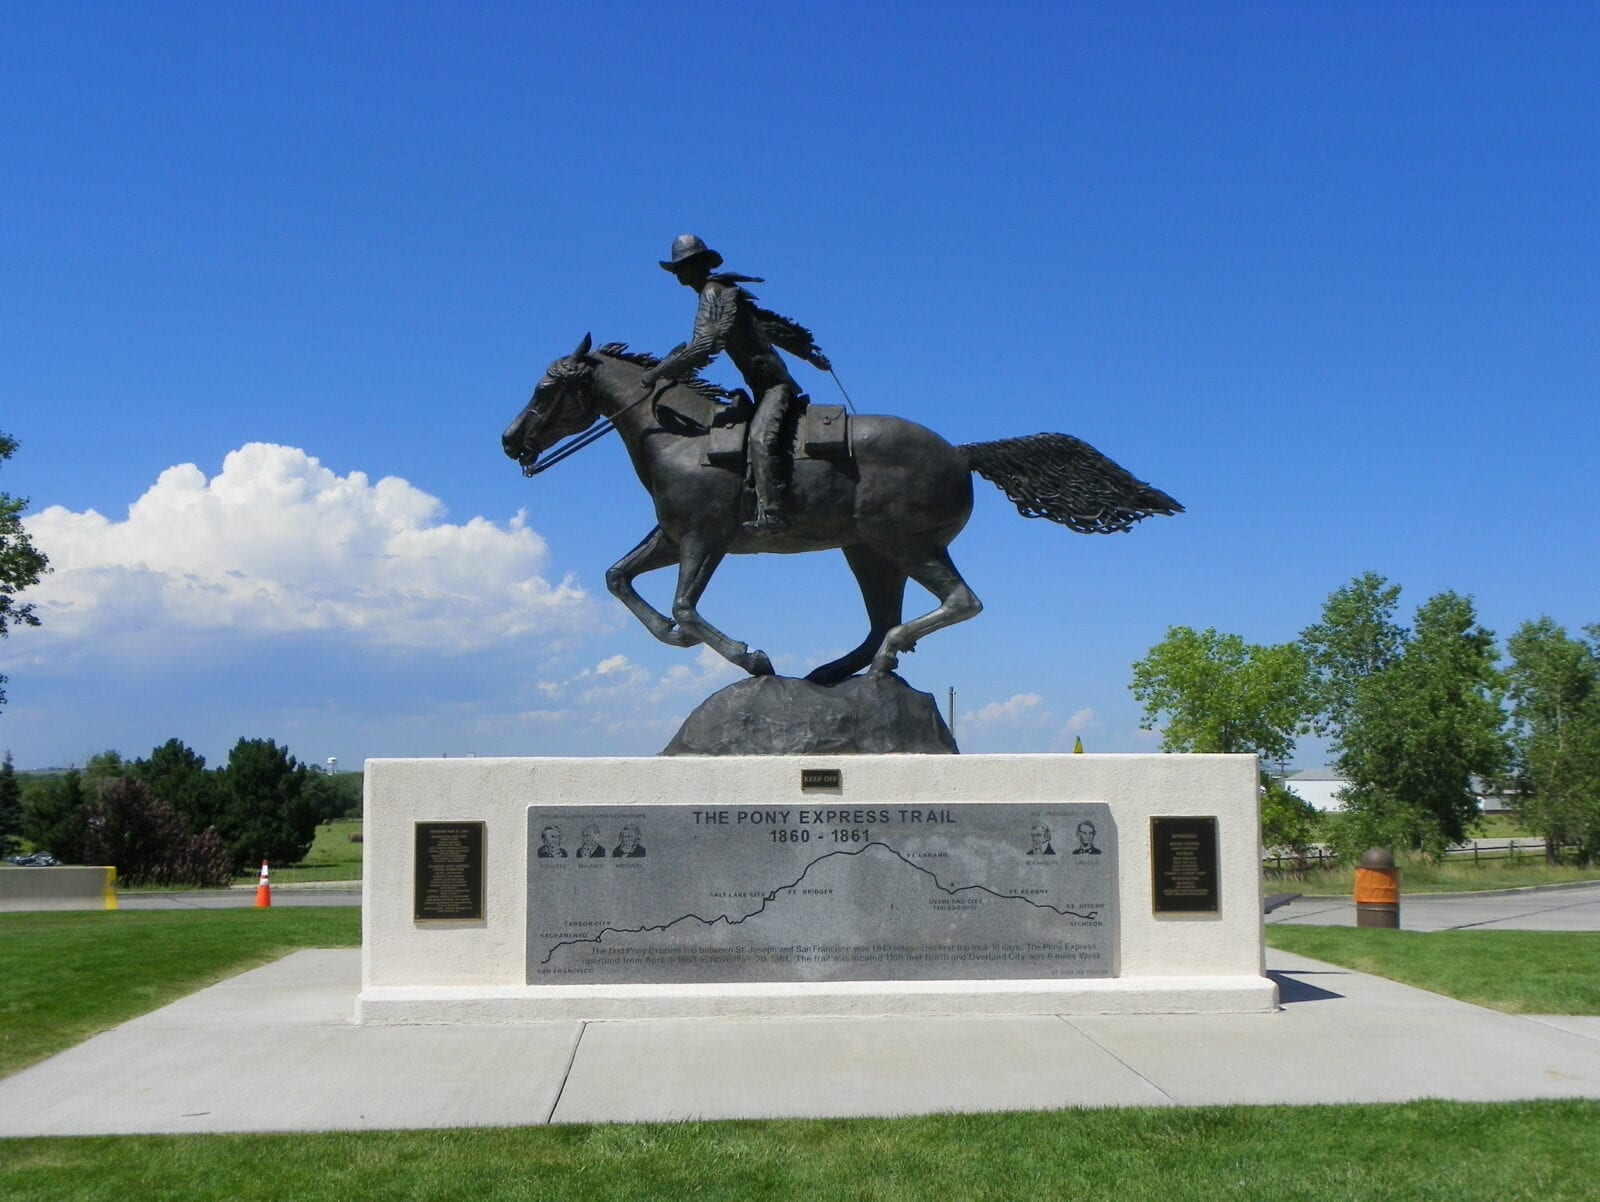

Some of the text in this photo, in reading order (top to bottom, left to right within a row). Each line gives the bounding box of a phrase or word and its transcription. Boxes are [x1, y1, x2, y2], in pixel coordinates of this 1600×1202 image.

[692, 810, 956, 824] THE PONY EXPRESS TRAIL
[769, 829, 810, 842] 1860
[831, 829, 870, 842] 1861
[628, 947, 646, 957] Pony
[779, 945, 793, 953] and
[796, 945, 811, 953] San
[1043, 942, 1062, 952] Pony
[1064, 942, 1097, 952] Express
[1008, 953, 1025, 962] City
